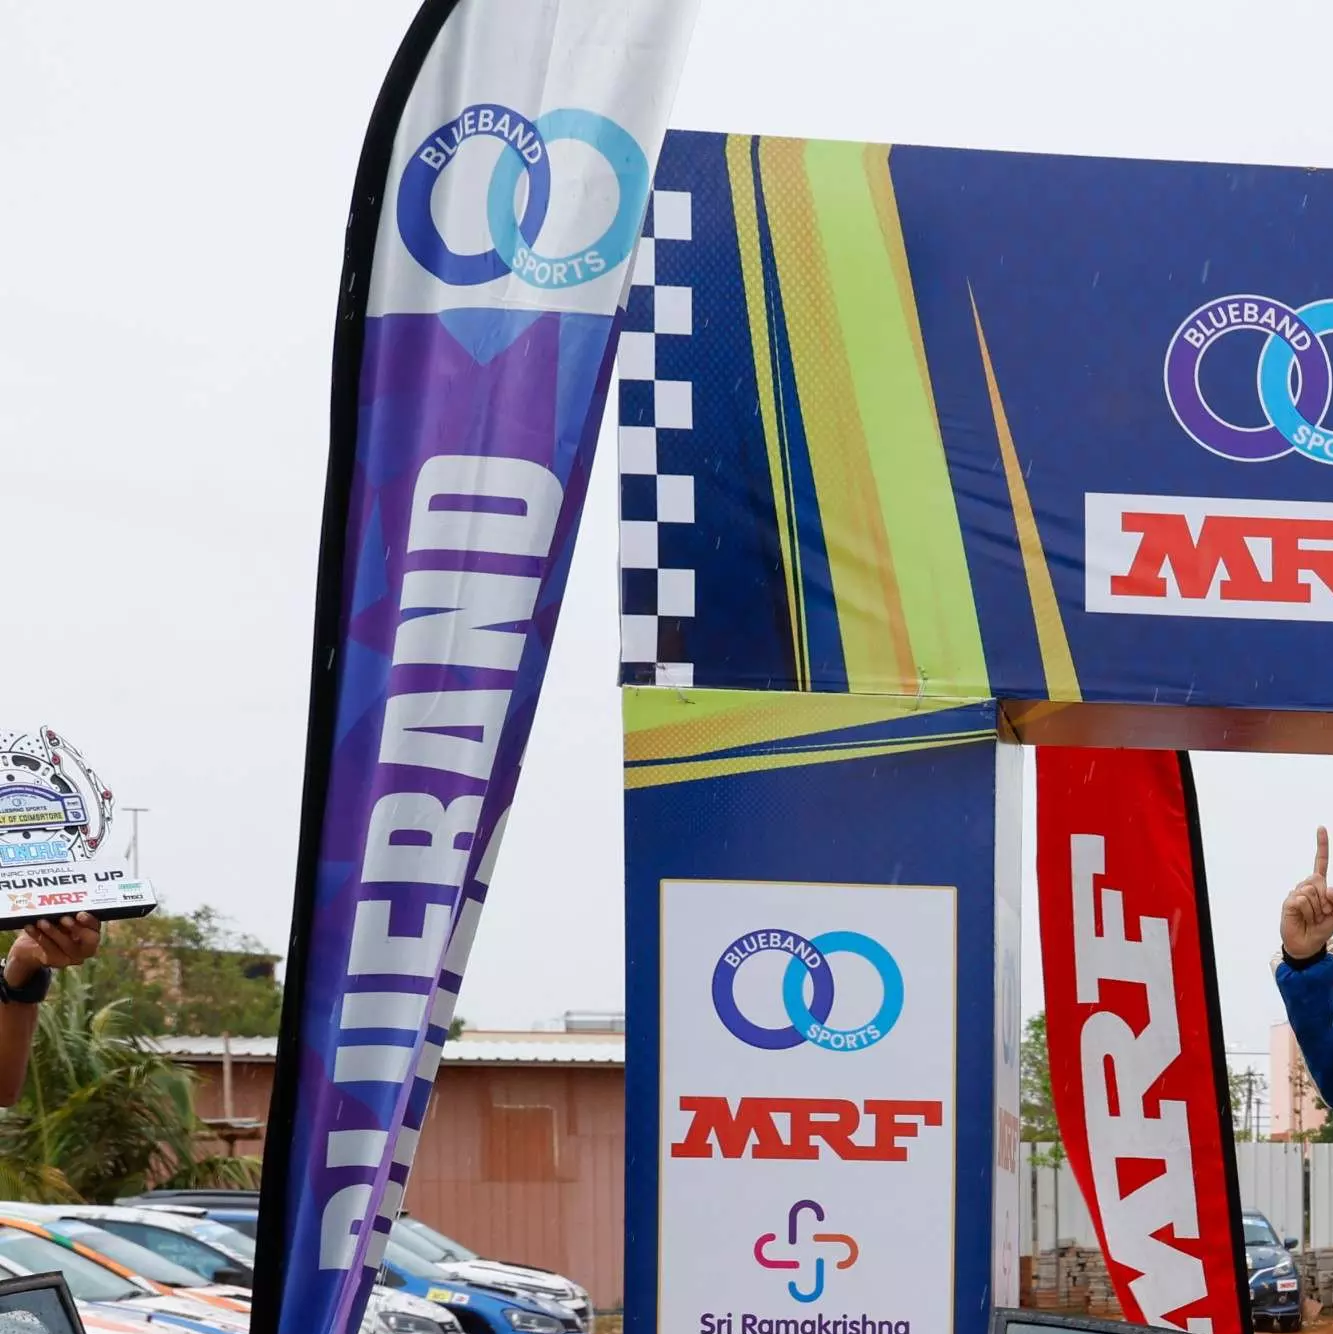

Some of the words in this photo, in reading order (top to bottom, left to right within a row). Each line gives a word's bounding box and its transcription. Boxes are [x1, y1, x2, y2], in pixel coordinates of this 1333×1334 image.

[419, 109, 546, 173] BLUEBAND
[511, 247, 608, 288] SPORTS
[1183, 302, 1312, 353] BLUEBAND
[95, 870, 124, 882] UP
[37, 891, 88, 906] MRF
[724, 932, 822, 969] BLUEBAND
[806, 1023, 881, 1048] SPORTS
[671, 1096, 943, 1162] MRF
